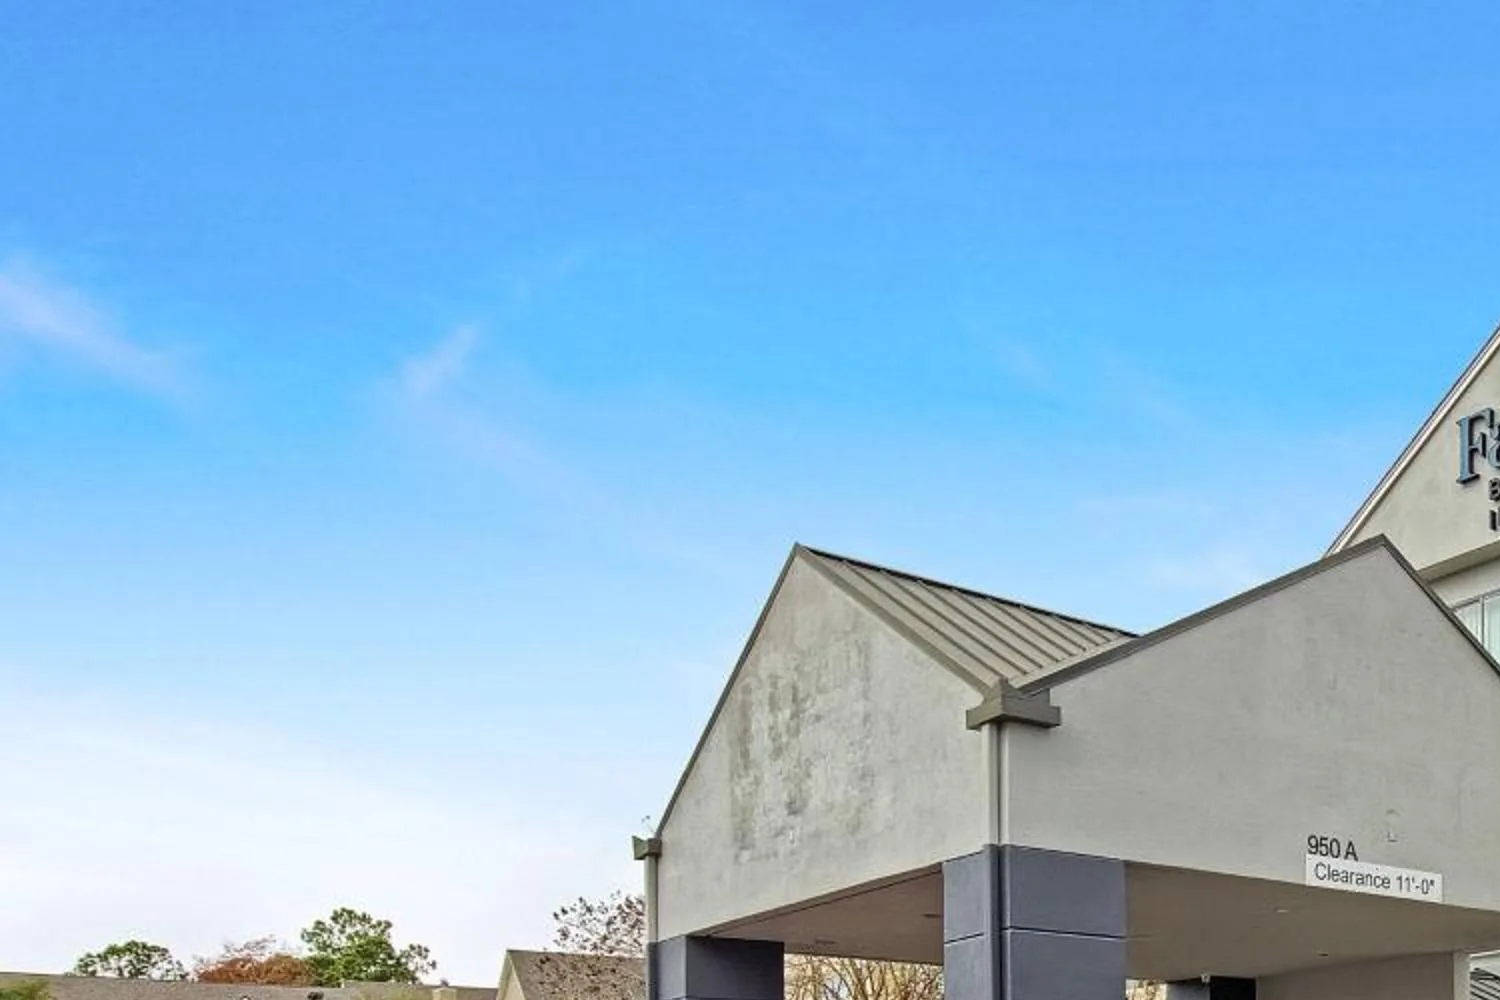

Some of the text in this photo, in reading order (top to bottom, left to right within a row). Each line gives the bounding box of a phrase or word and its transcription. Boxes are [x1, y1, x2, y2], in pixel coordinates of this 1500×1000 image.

[1307, 835, 1359, 861] 950 A
[1314, 862, 1391, 889] Clearance
